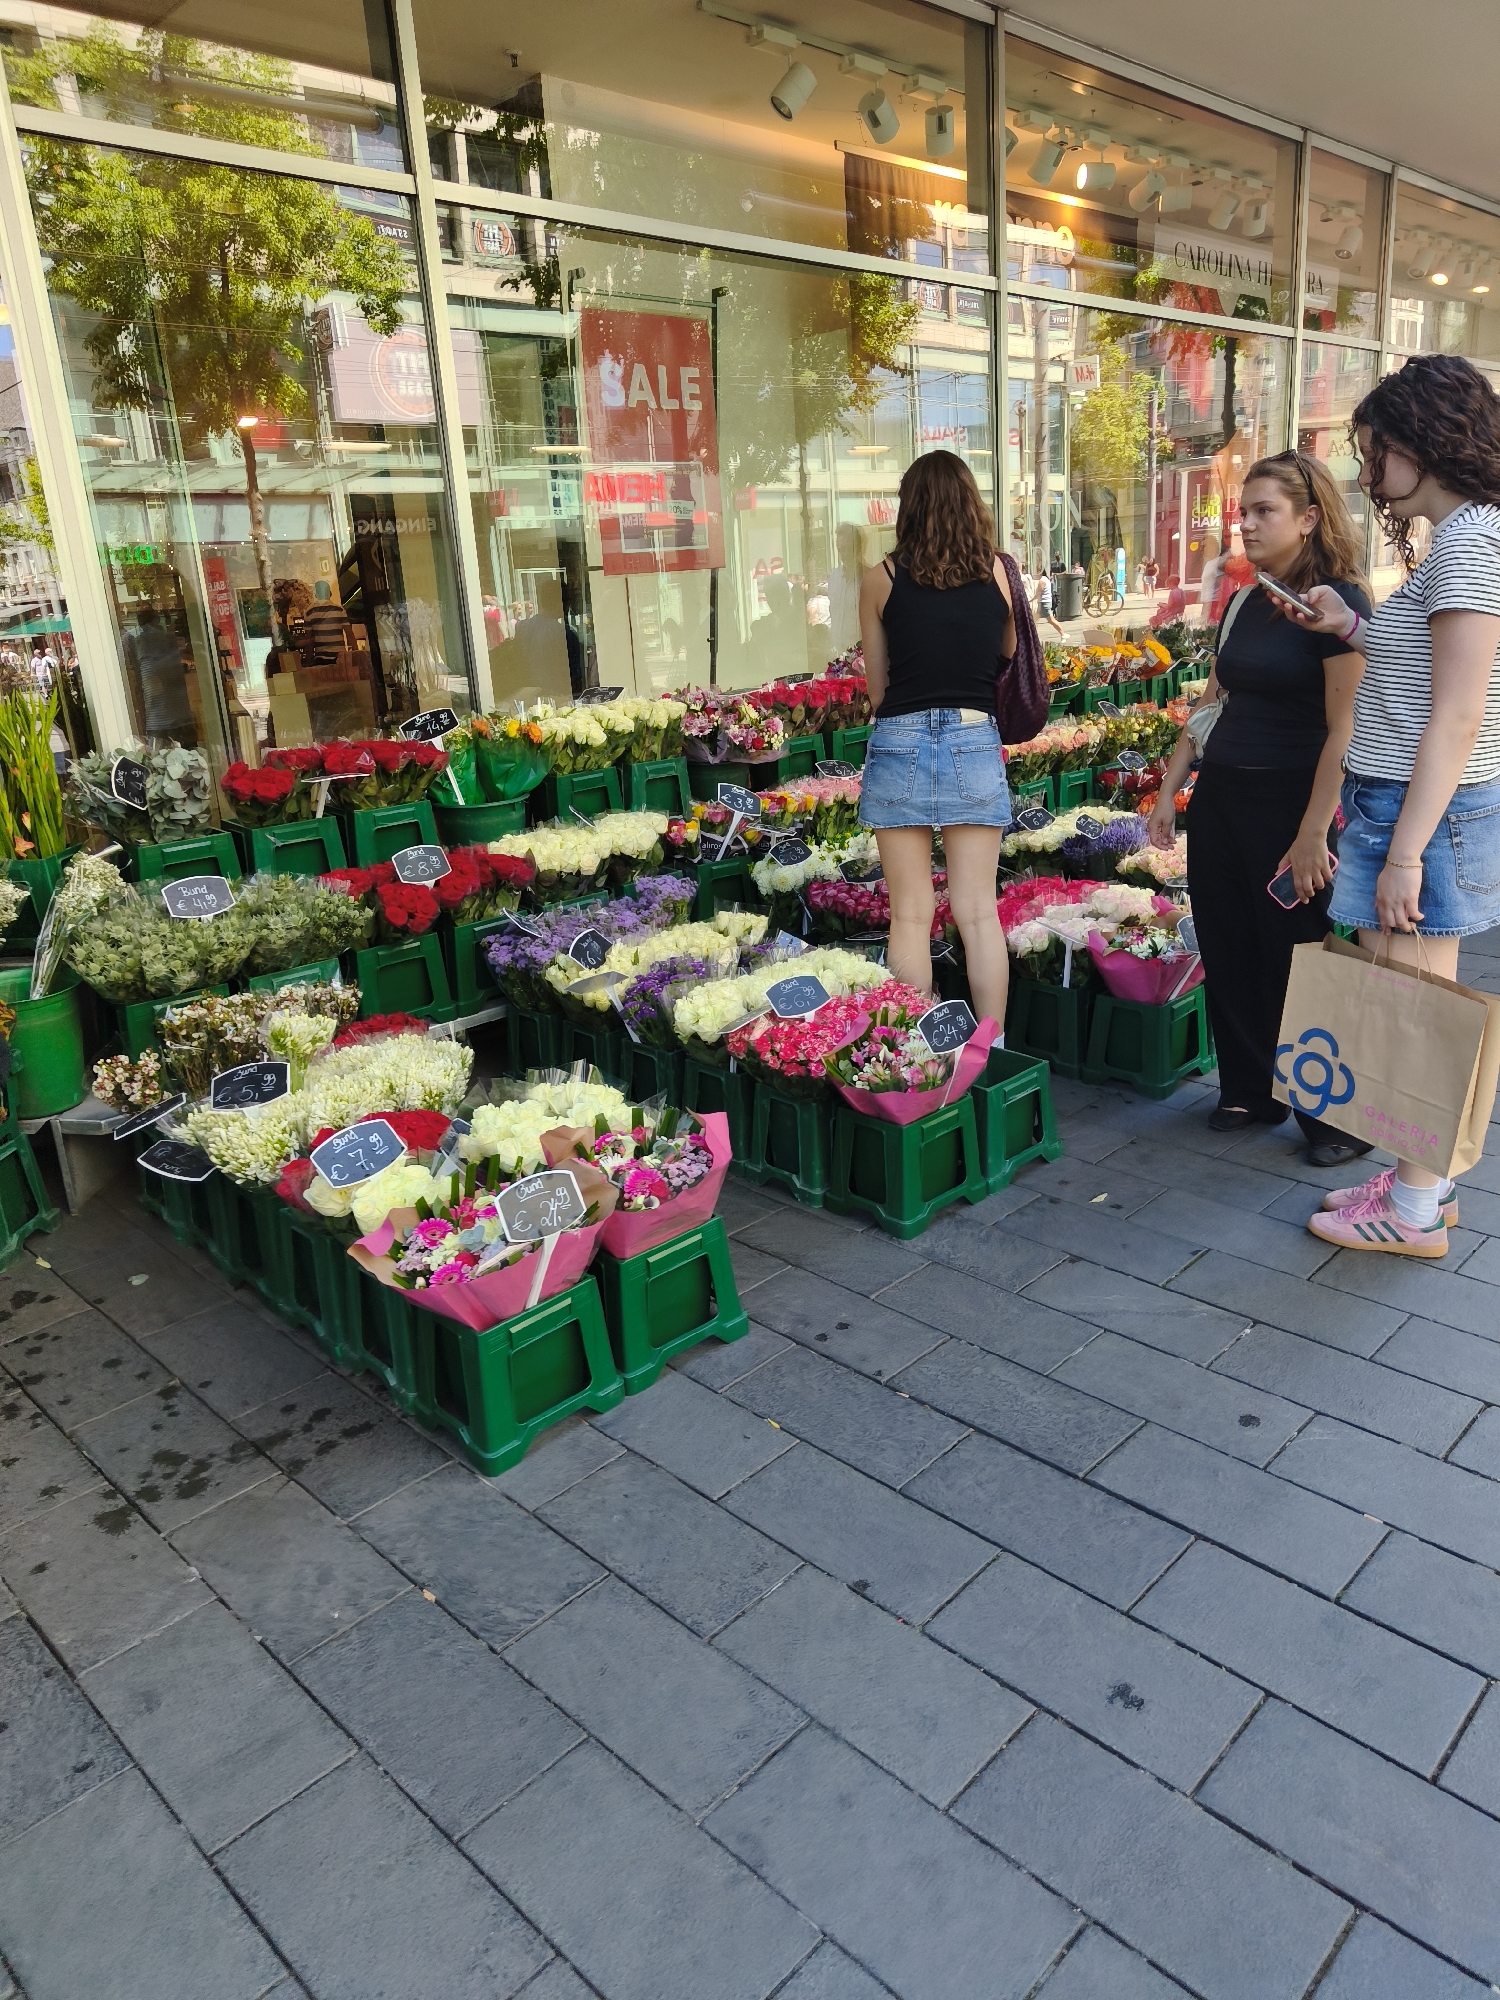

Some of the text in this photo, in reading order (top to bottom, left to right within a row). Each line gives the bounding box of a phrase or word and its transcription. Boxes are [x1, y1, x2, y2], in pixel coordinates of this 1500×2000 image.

[1174, 241, 1252, 281] CAROLINA
[600, 360, 703, 410] SALE
[402, 865, 415, 877] €
[178, 885, 208, 896] Bund
[176, 900, 187, 911] €
[780, 980, 799, 992] Bund
[779, 998, 792, 1010] €
[216, 1074, 276, 1103] € 5,99
[1365, 1106, 1438, 1147] GALERIA
[333, 1130, 358, 1149] Bund
[1370, 1124, 1426, 1156] galeria.de
[331, 1164, 349, 1180] €
[516, 1178, 544, 1199] Bund
[512, 1211, 532, 1232] €
